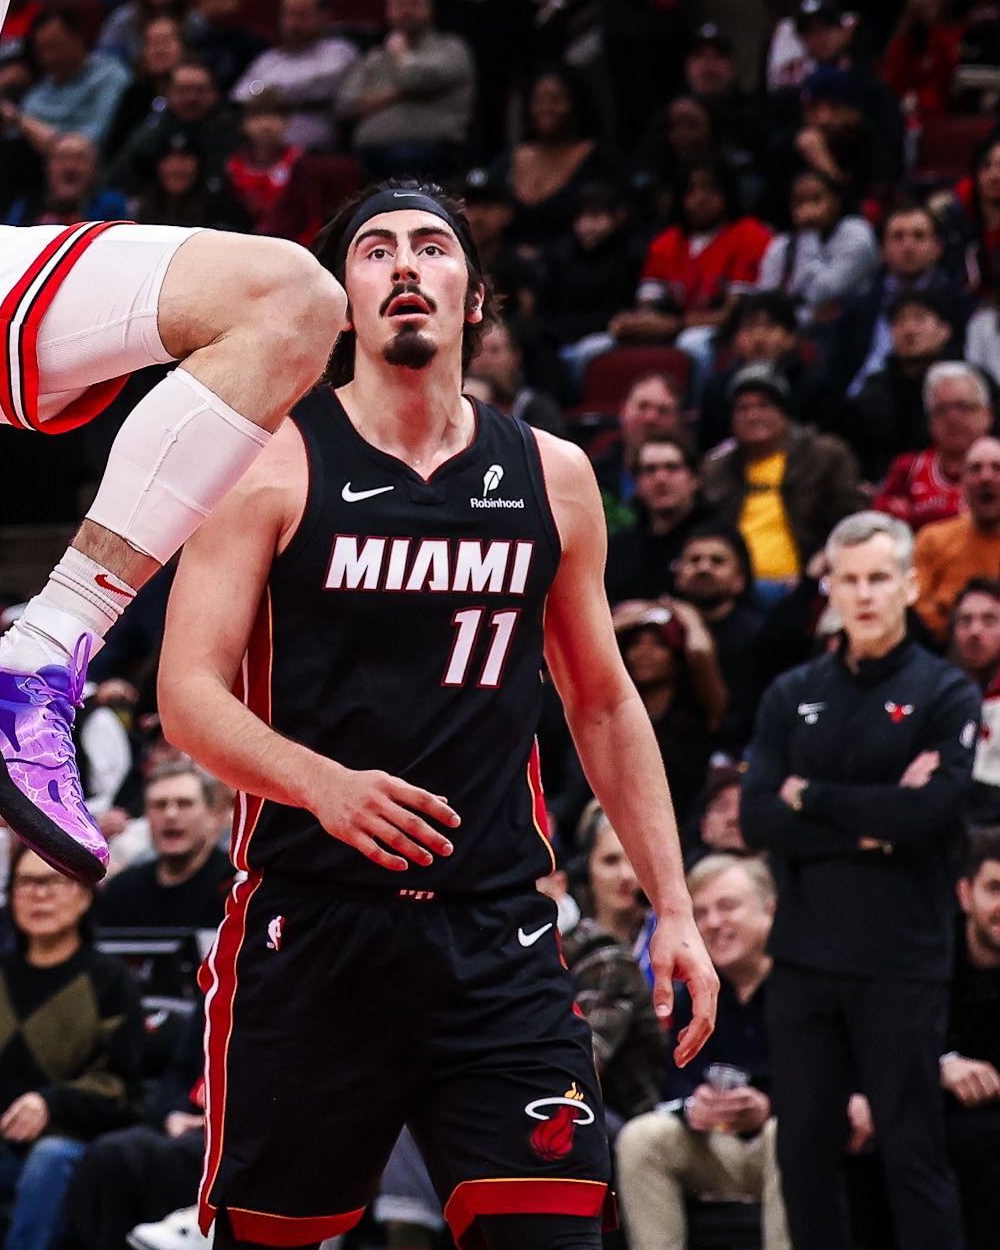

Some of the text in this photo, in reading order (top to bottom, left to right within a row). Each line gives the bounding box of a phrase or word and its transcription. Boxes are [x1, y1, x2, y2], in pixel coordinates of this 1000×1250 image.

[470, 498, 525, 509] Robinhood
[322, 534, 536, 596] MIAMI
[441, 606, 521, 688] 11
